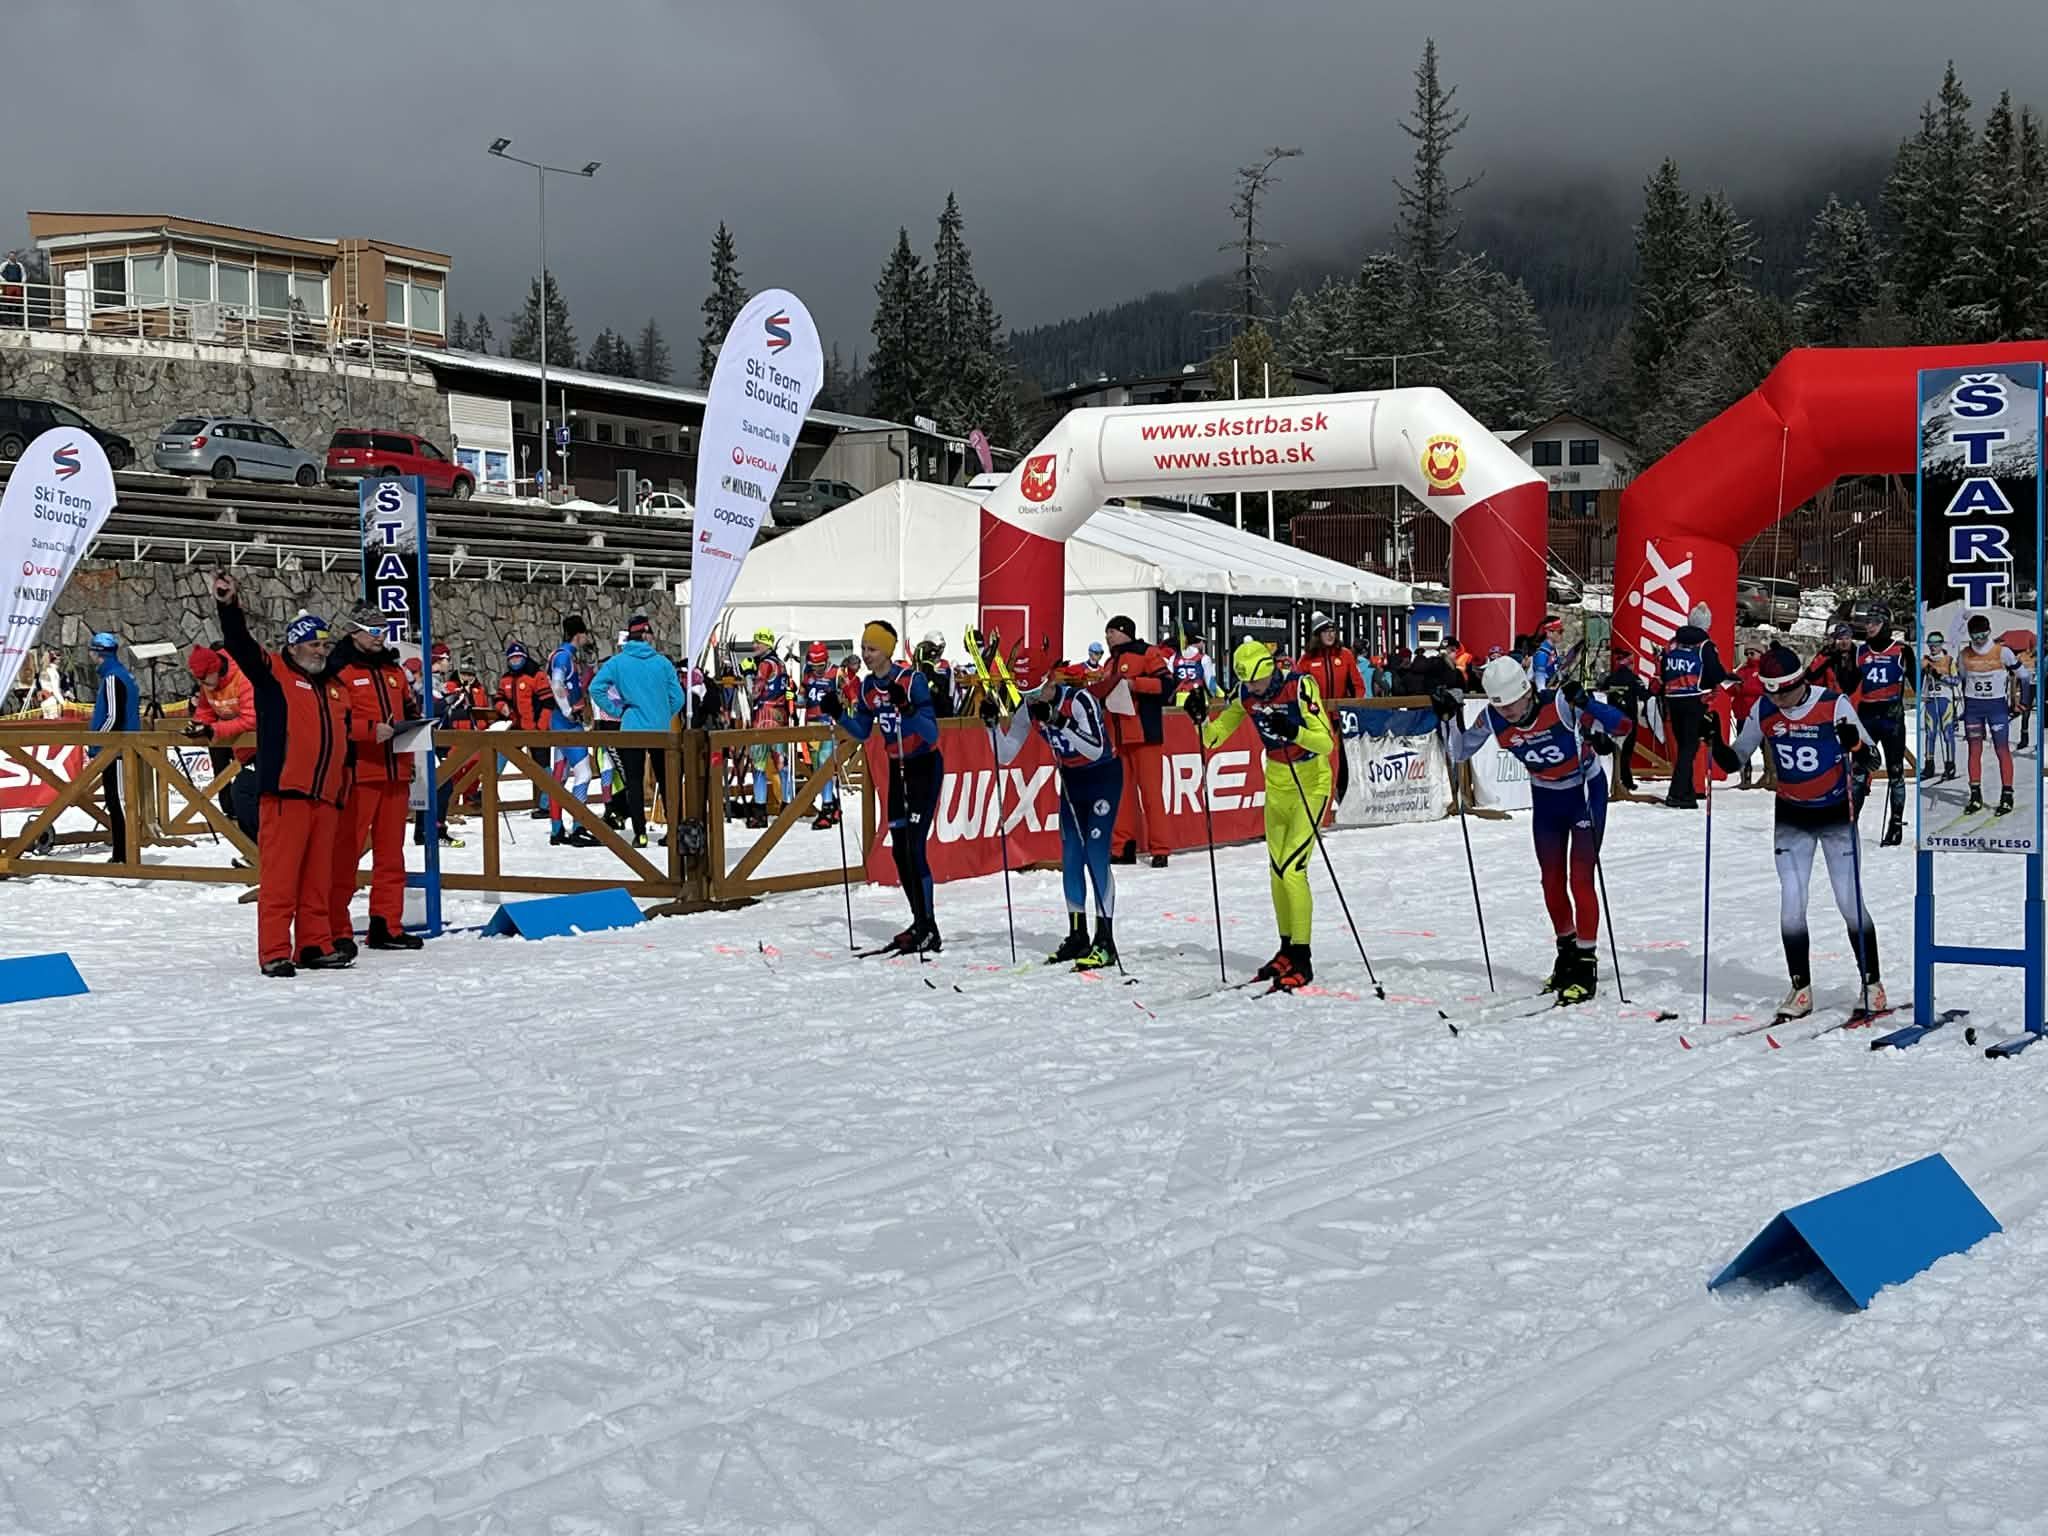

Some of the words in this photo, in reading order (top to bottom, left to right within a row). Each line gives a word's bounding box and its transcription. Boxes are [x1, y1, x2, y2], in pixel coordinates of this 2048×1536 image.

[745, 358, 765, 380] Ski
[768, 366, 801, 395] Team
[744, 380, 799, 415] Slovakia
[1141, 412, 1329, 441] www.skstrba.sk
[746, 455, 778, 474] VEOLIA
[1153, 442, 1316, 470] www.strba.sk
[33, 485, 55, 503] Ski
[57, 489, 93, 512] Team
[1944, 372, 2015, 610] ŠTART
[33, 503, 88, 529] Slovakia
[375, 482, 410, 645] ŠTART
[1177, 667, 1197, 680] 35
[1666, 657, 1696, 673] JURY
[1866, 667, 1889, 684] 41
[1973, 681, 1993, 692] 63
[1524, 744, 1566, 765] 43
[1775, 743, 1820, 773] 58
[1989, 839, 2032, 849] PLESO
